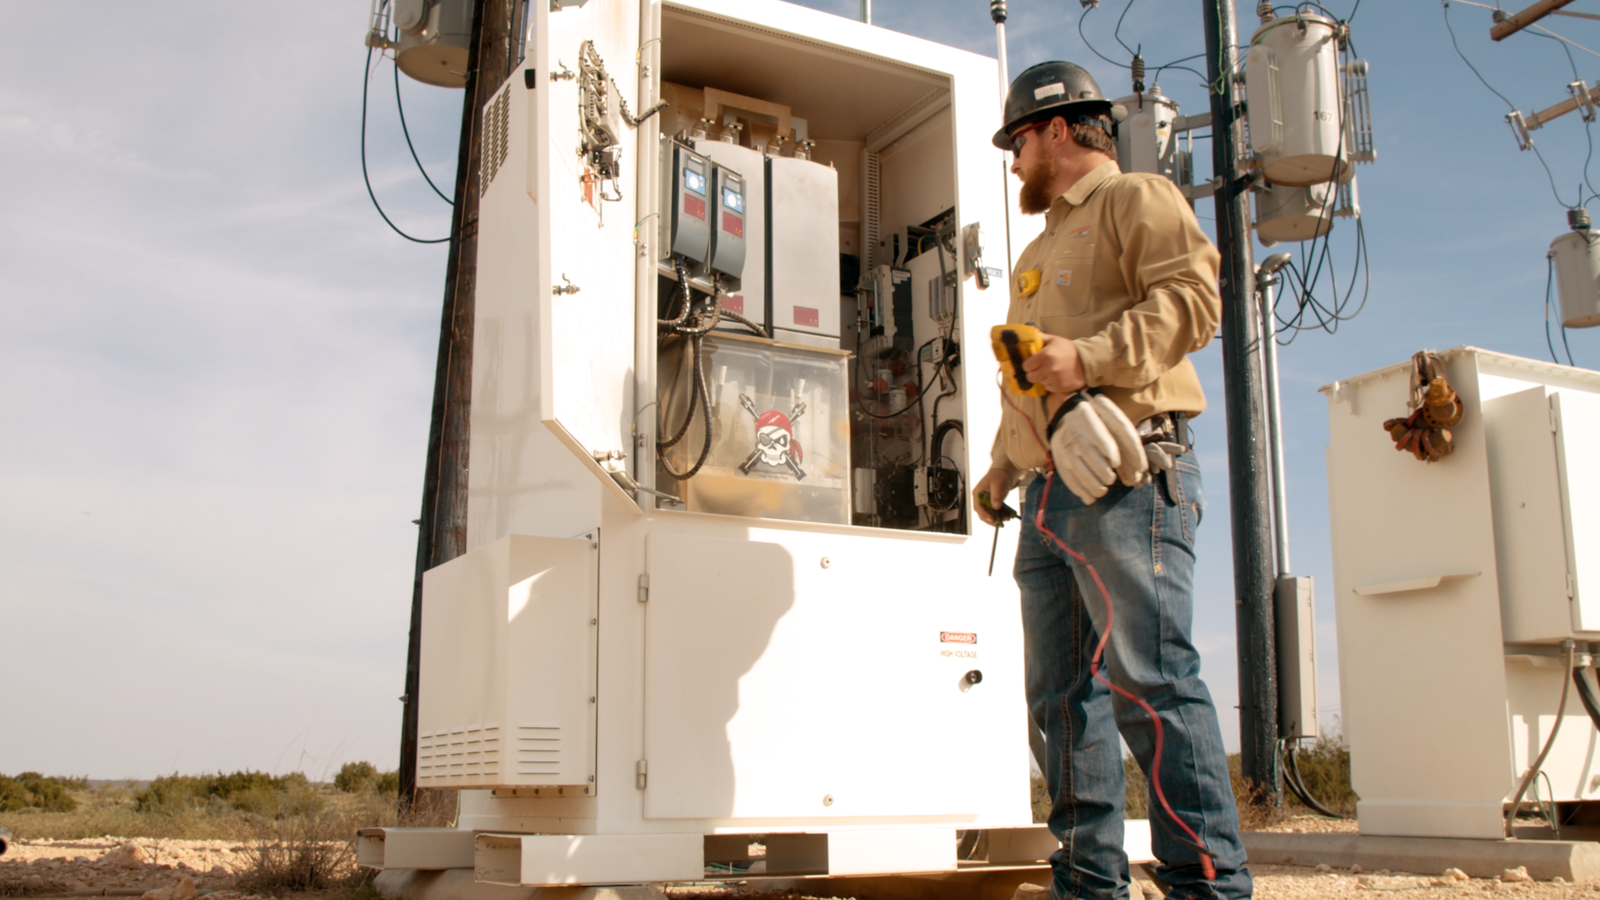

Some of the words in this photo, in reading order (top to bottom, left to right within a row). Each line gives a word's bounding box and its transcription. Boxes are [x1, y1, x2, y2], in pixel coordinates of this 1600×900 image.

[1312, 110, 1333, 122] 167
[945, 634, 972, 642] DANGER
[940, 649, 953, 657] HIGH
[954, 650, 977, 659] VOLTAGE
